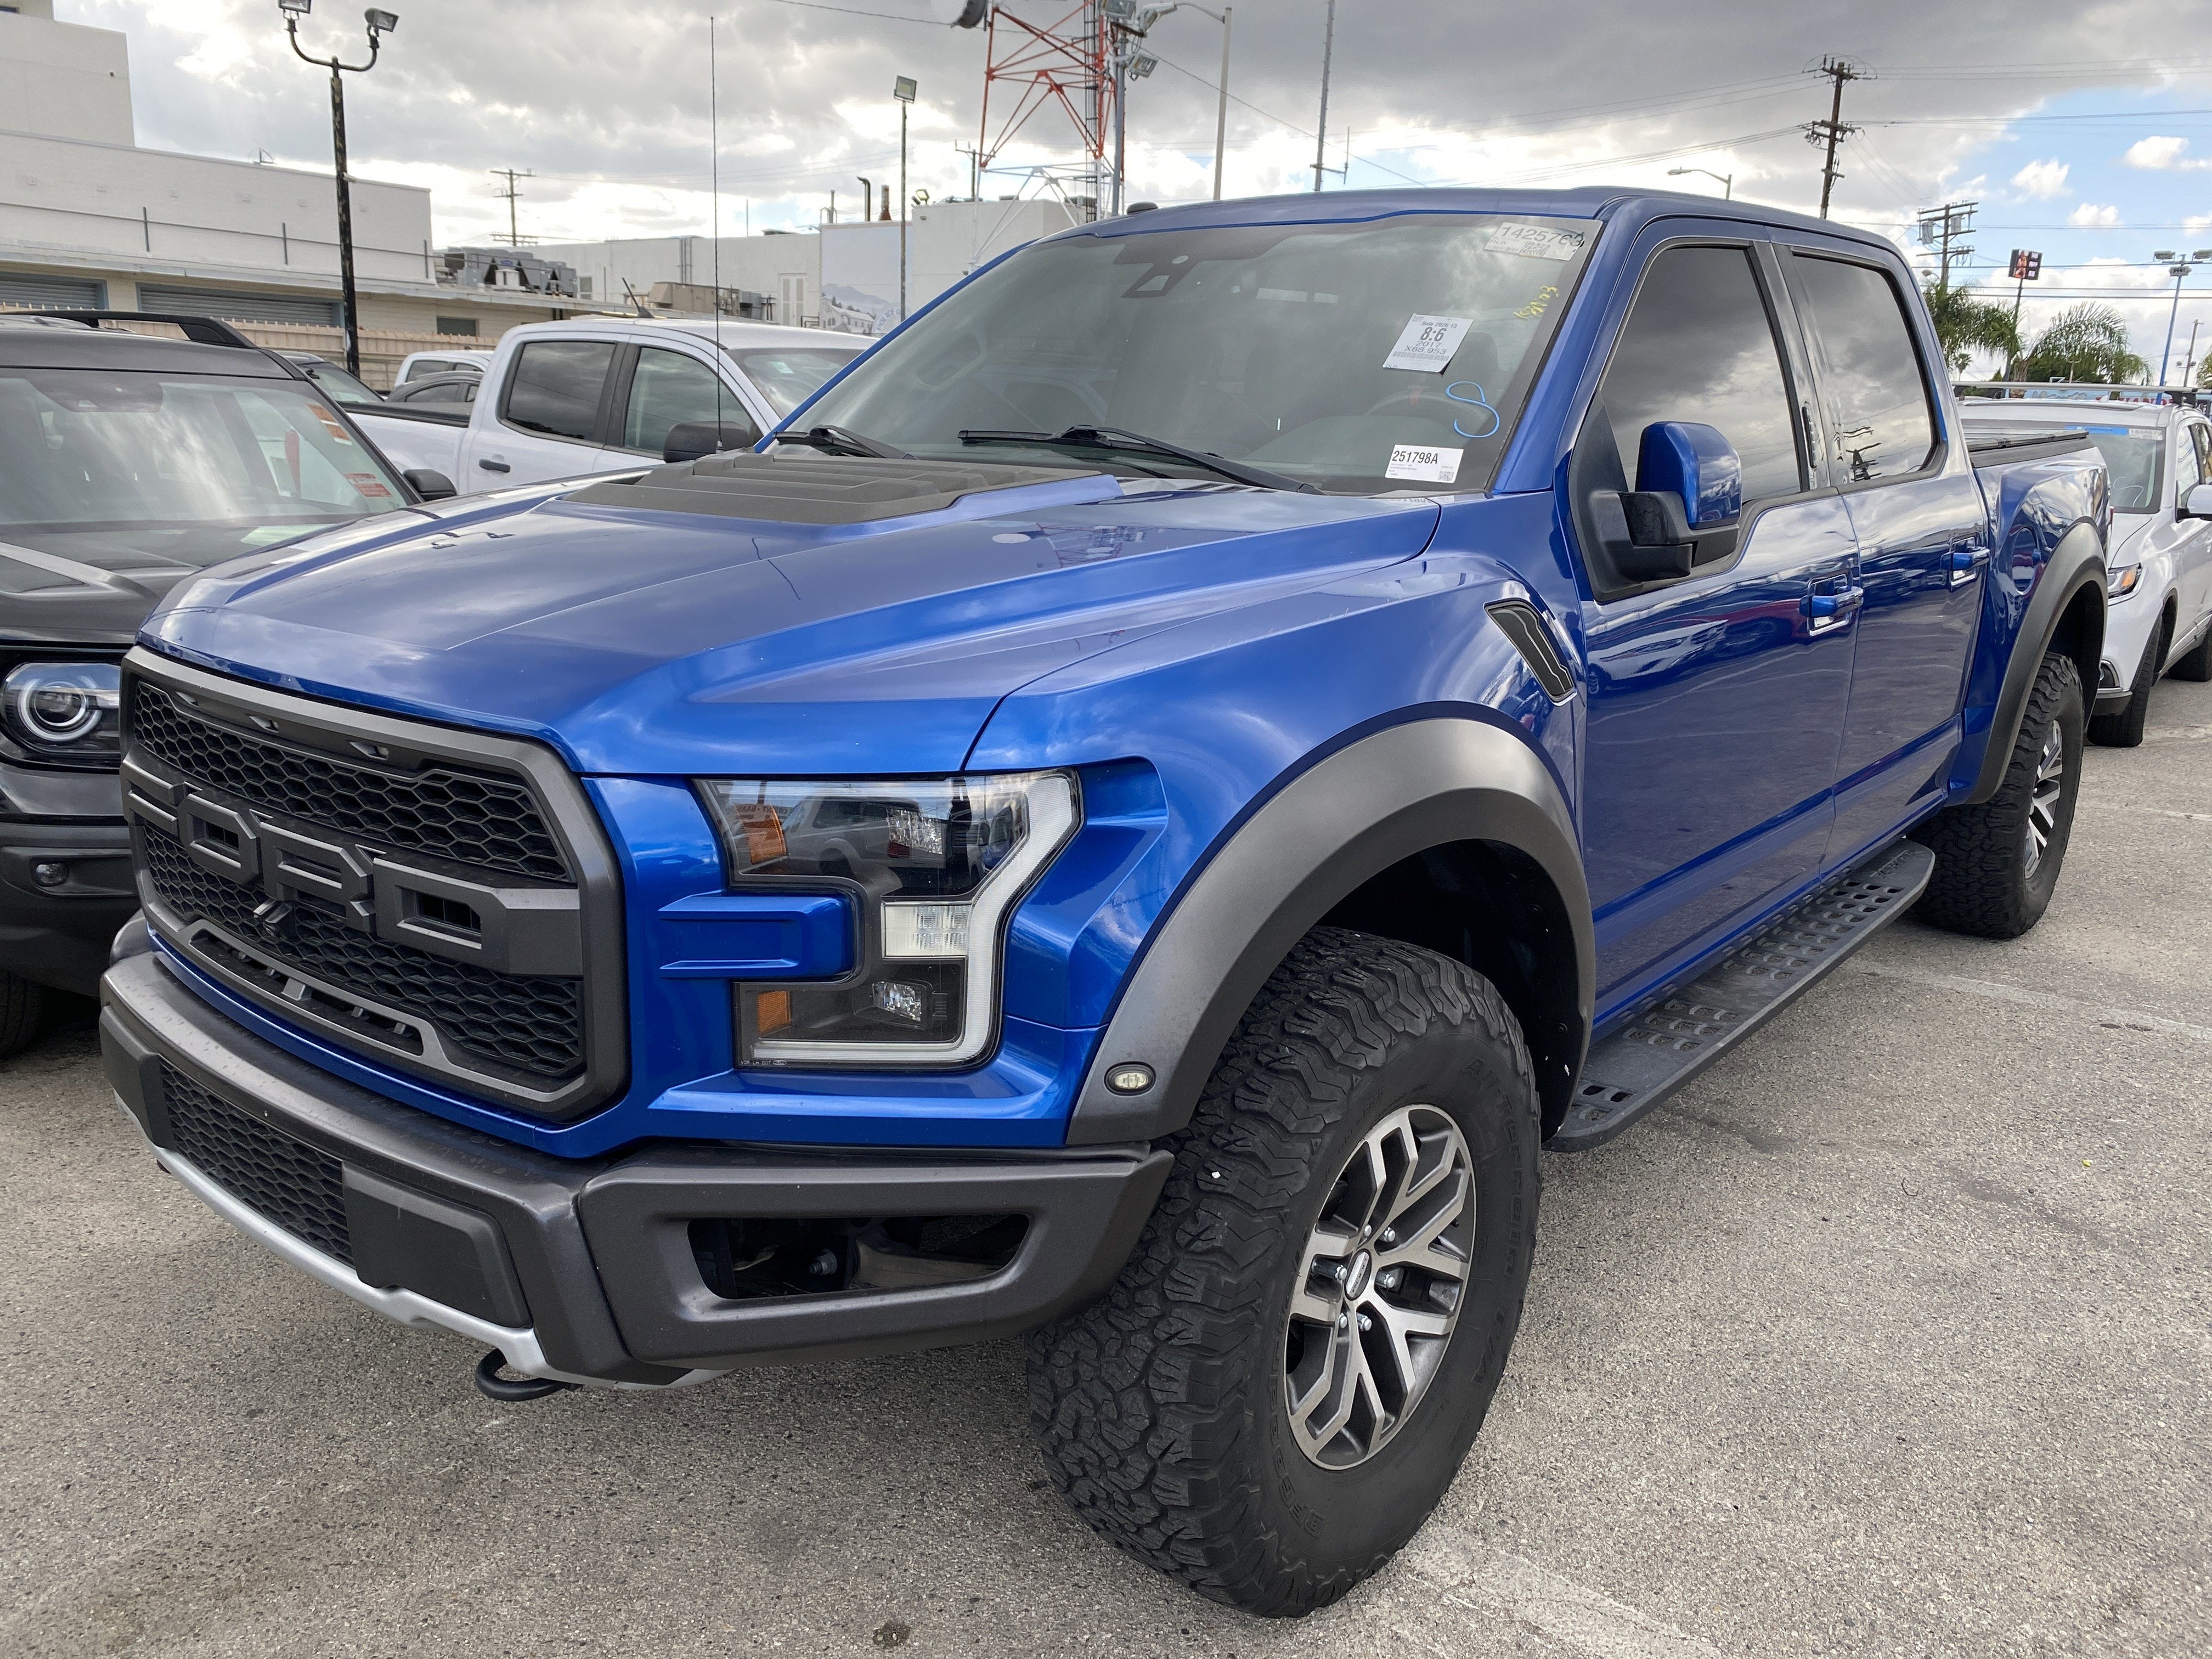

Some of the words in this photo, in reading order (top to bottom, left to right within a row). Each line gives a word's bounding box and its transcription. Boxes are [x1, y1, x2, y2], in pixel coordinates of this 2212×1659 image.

[1420, 326, 1447, 341] 8:6
[1392, 450, 1438, 464] 251798A
[121, 752, 516, 974] FORD
[1463, 1056, 1523, 1276] All-Terrain
